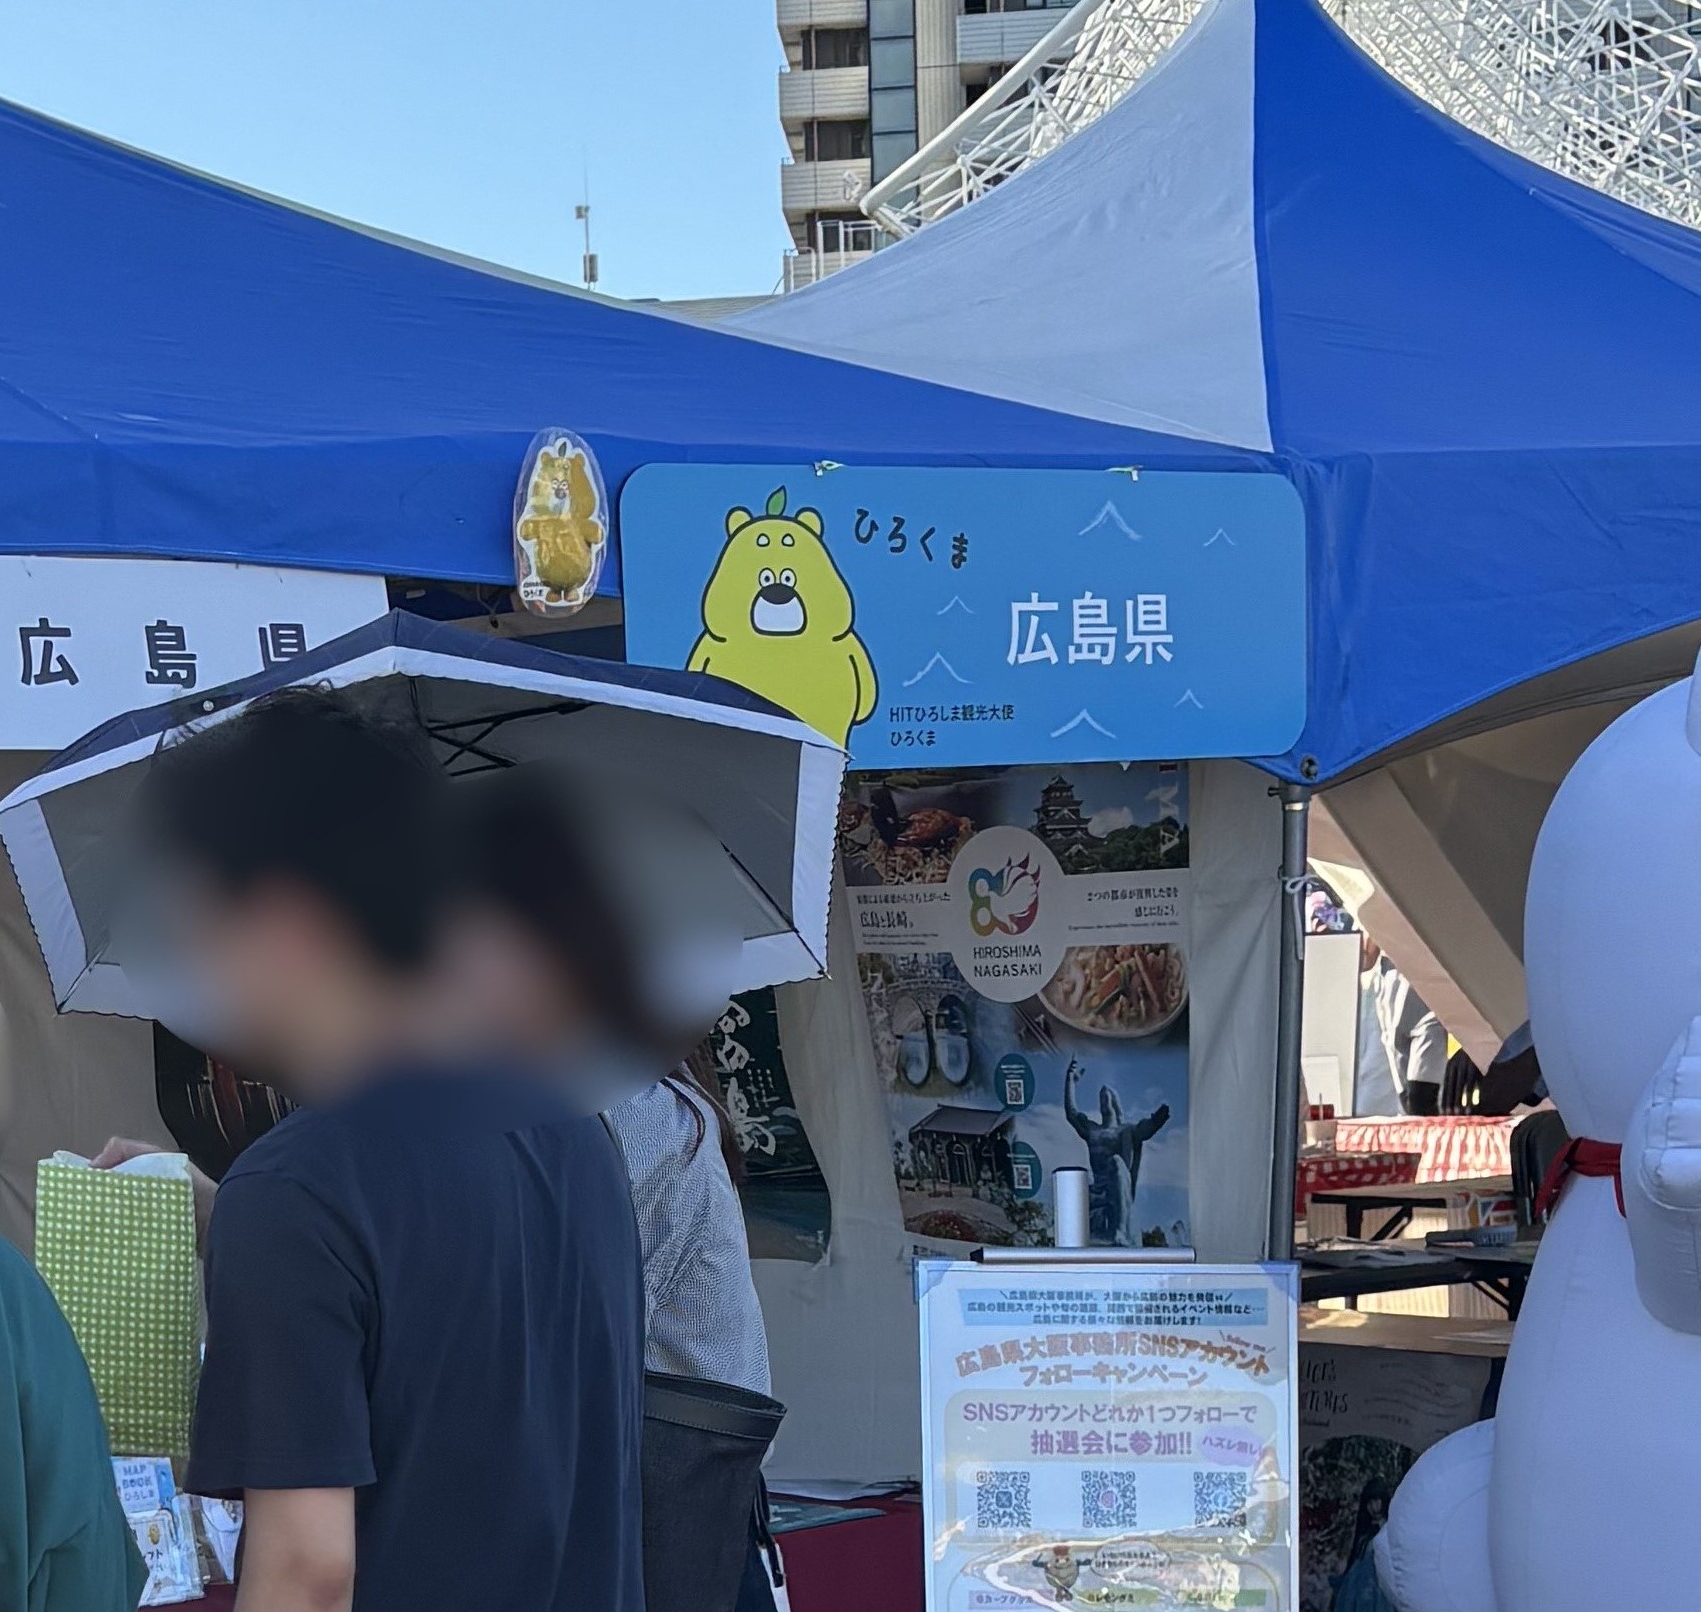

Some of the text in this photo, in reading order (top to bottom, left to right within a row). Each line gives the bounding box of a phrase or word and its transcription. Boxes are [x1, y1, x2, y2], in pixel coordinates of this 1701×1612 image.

[854, 497, 969, 570] ひろくま
[1006, 591, 1174, 666] 広島県
[889, 704, 1015, 723] HITひろしま観光大使
[890, 730, 937, 747] ひろくま
[973, 944, 1042, 959] HIROSHIMA
[973, 963, 1042, 978] NAGASAKI
[954, 1331, 1271, 1377] 広島県大阪事務所SNSアカウント
[1019, 1361, 1208, 1387] フォローキャンペーン
[962, 1402, 1258, 1424] SNSアカウントどれか1つフォローで
[123, 1465, 147, 1476] MAP
